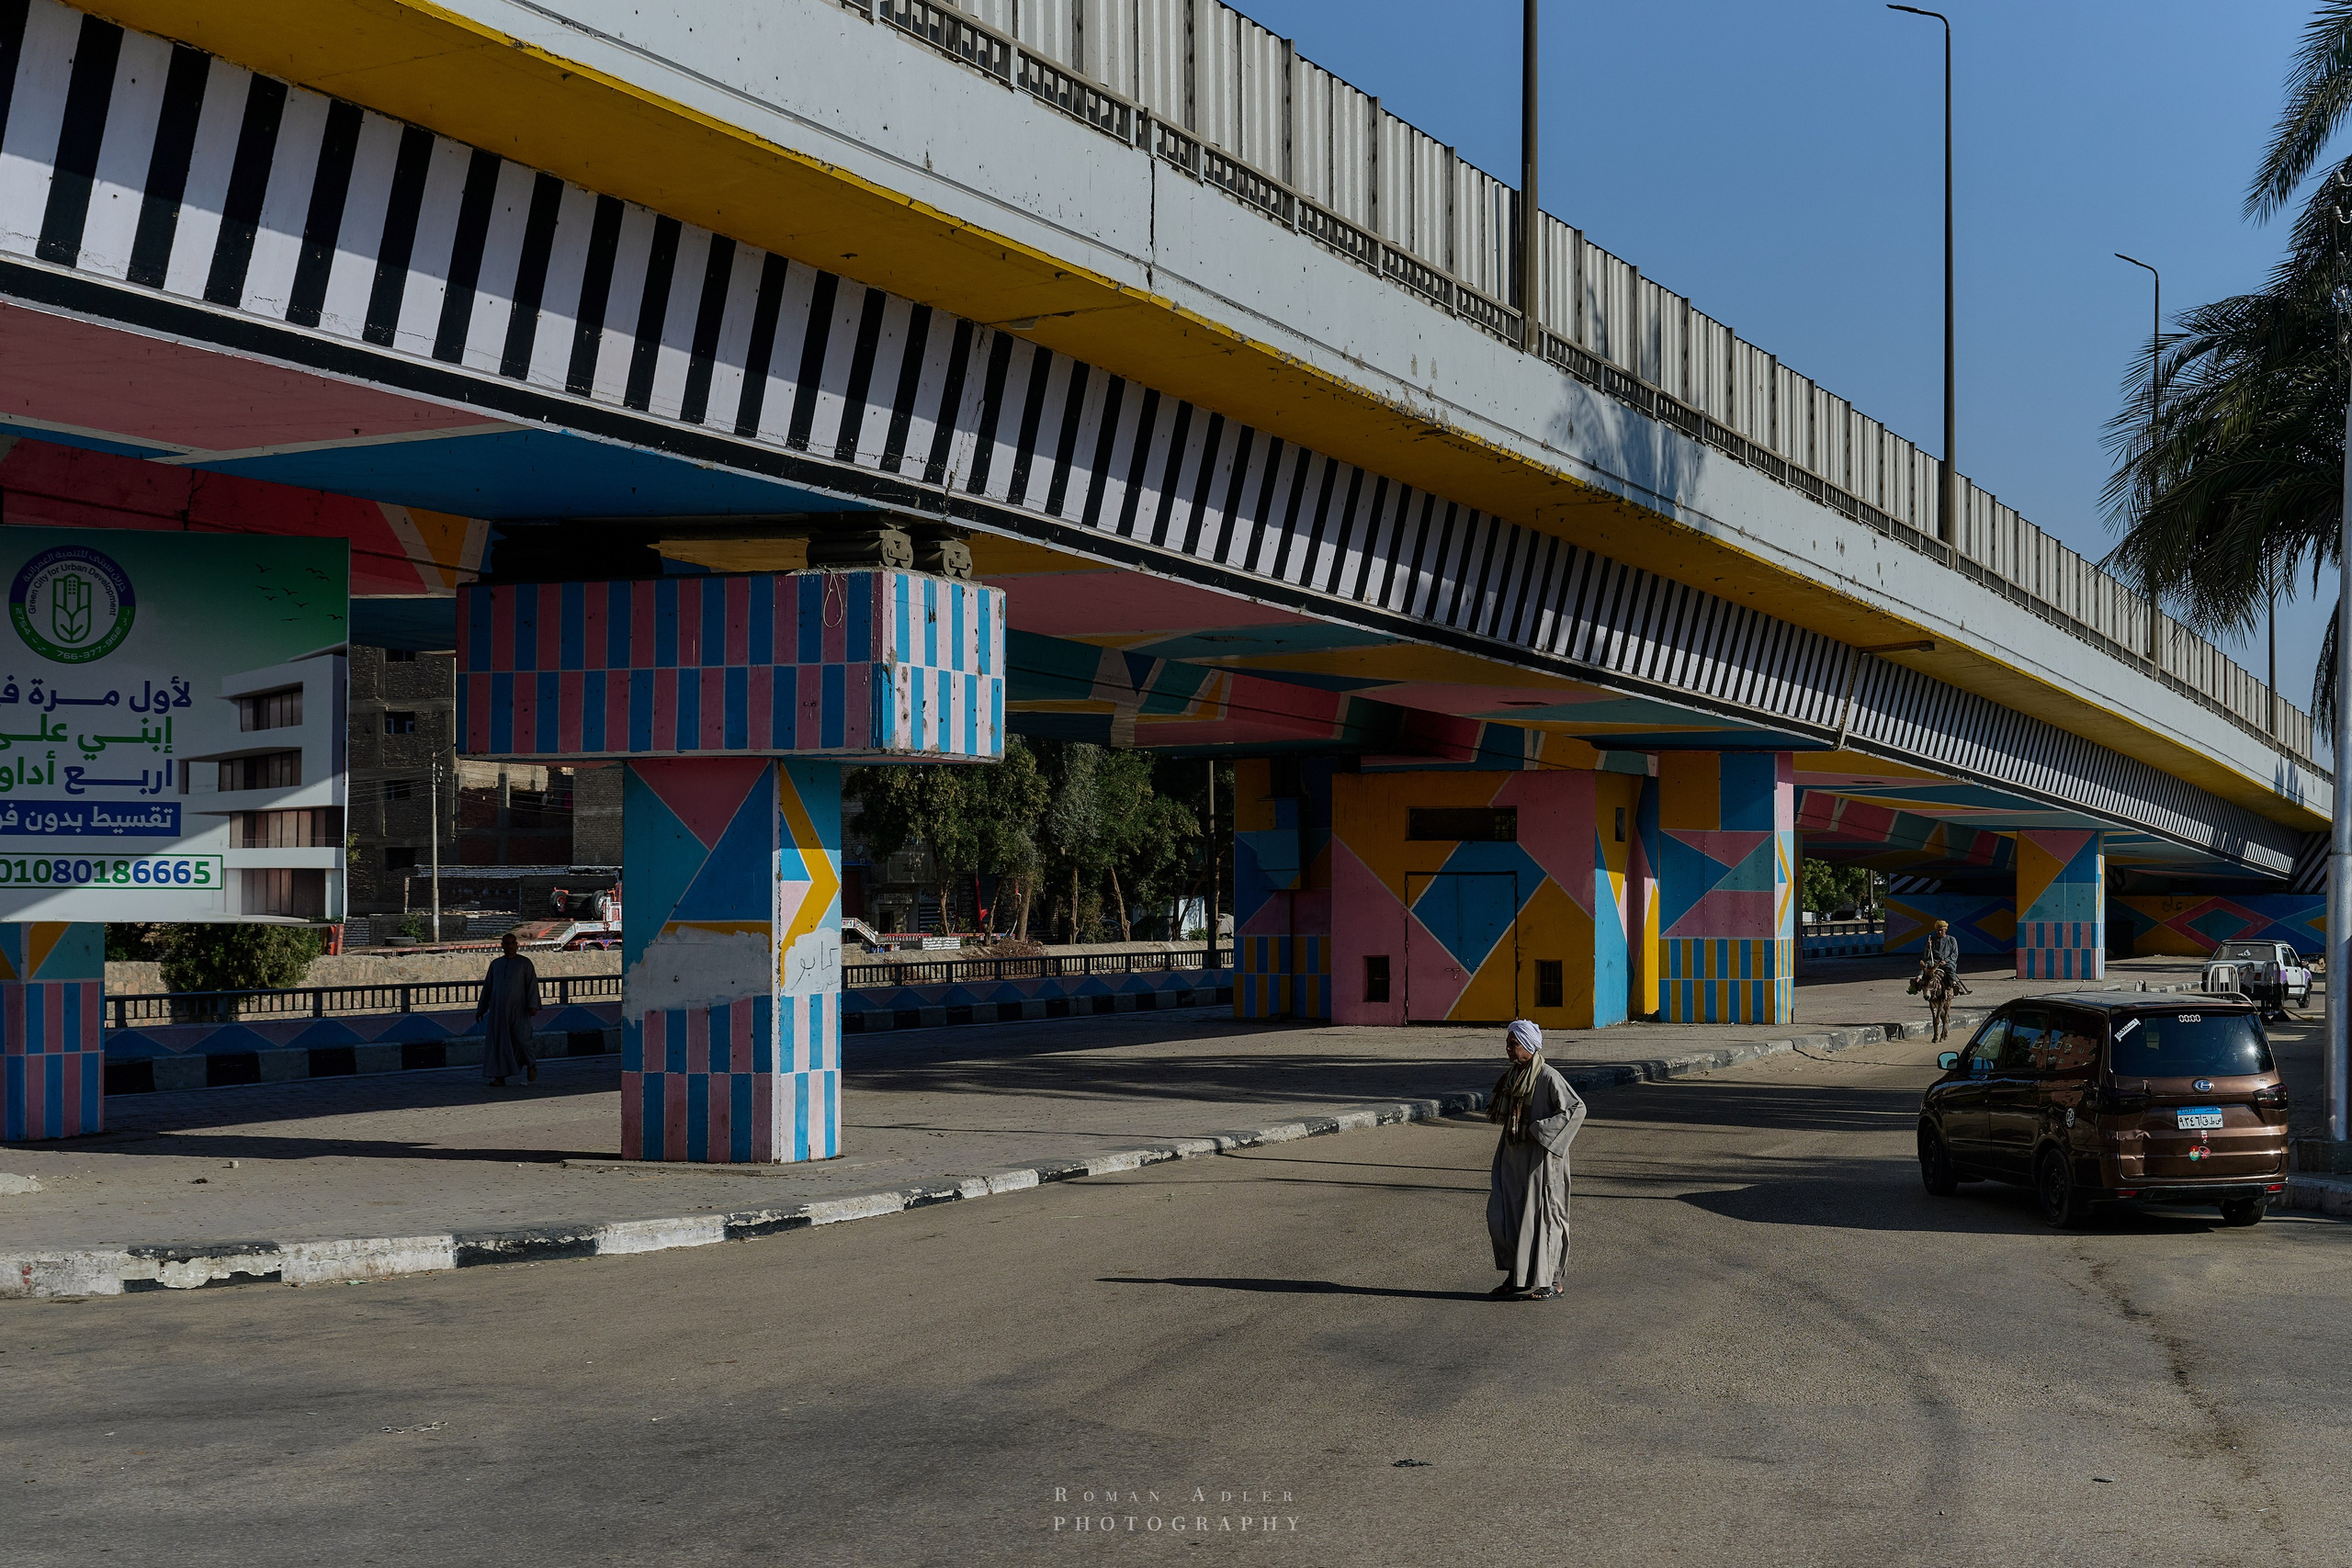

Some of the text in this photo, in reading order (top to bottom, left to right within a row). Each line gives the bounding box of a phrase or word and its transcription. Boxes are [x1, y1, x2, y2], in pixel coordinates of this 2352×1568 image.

[28, 563, 117, 616] Green City for Urban Development
[56, 626, 122, 660] 766-377-962
[28, 679, 119, 712] مرة
[130, 676, 192, 714] لأول
[77, 716, 173, 761] إبني
[64, 759, 173, 795] اربع
[25, 810, 83, 833] بدون
[90, 806, 174, 834] تقسيط
[0, 859, 210, 884] 01080186665
